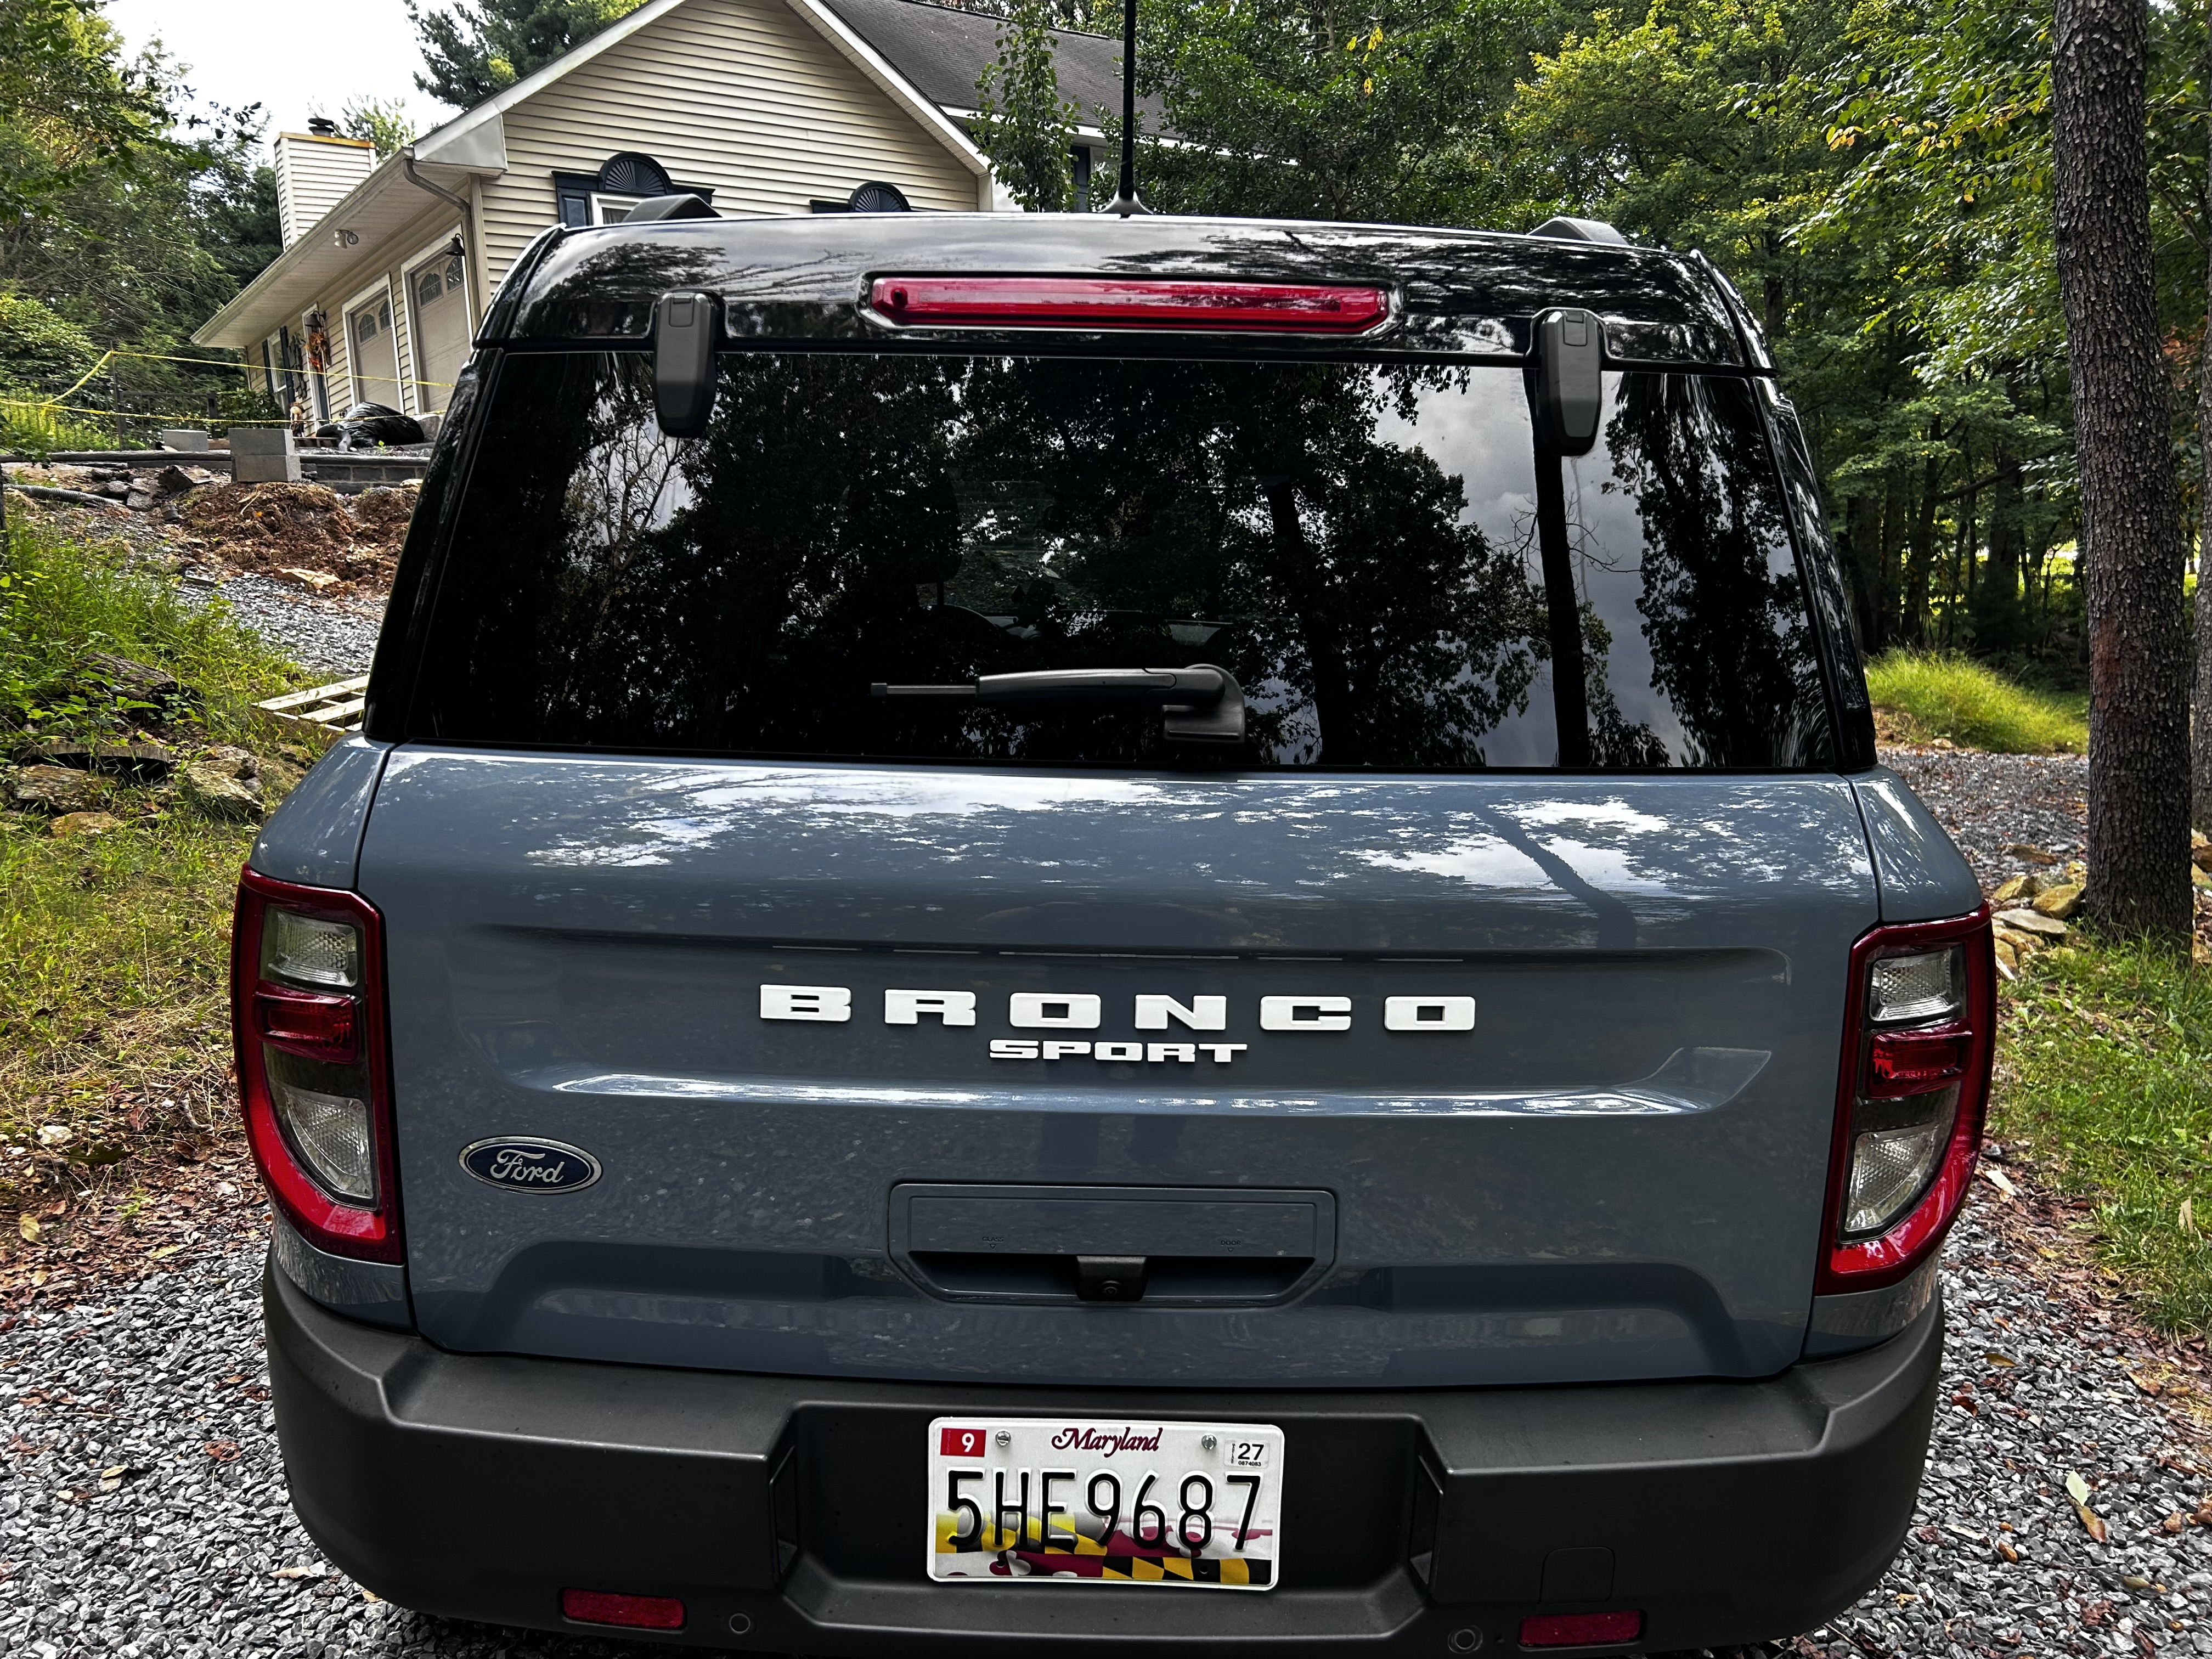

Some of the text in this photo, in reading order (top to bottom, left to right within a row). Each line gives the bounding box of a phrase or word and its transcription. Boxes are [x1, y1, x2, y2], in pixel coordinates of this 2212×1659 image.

[760, 984, 1476, 1031] BRONCO
[989, 1039, 1248, 1063] SPORT
[490, 1149, 565, 1183] Ford
[962, 1432, 975, 1453] 9
[1051, 1426, 1163, 1458] Maryland
[1238, 1442, 1265, 1461] 27
[947, 1470, 1262, 1550] 5HE9687
